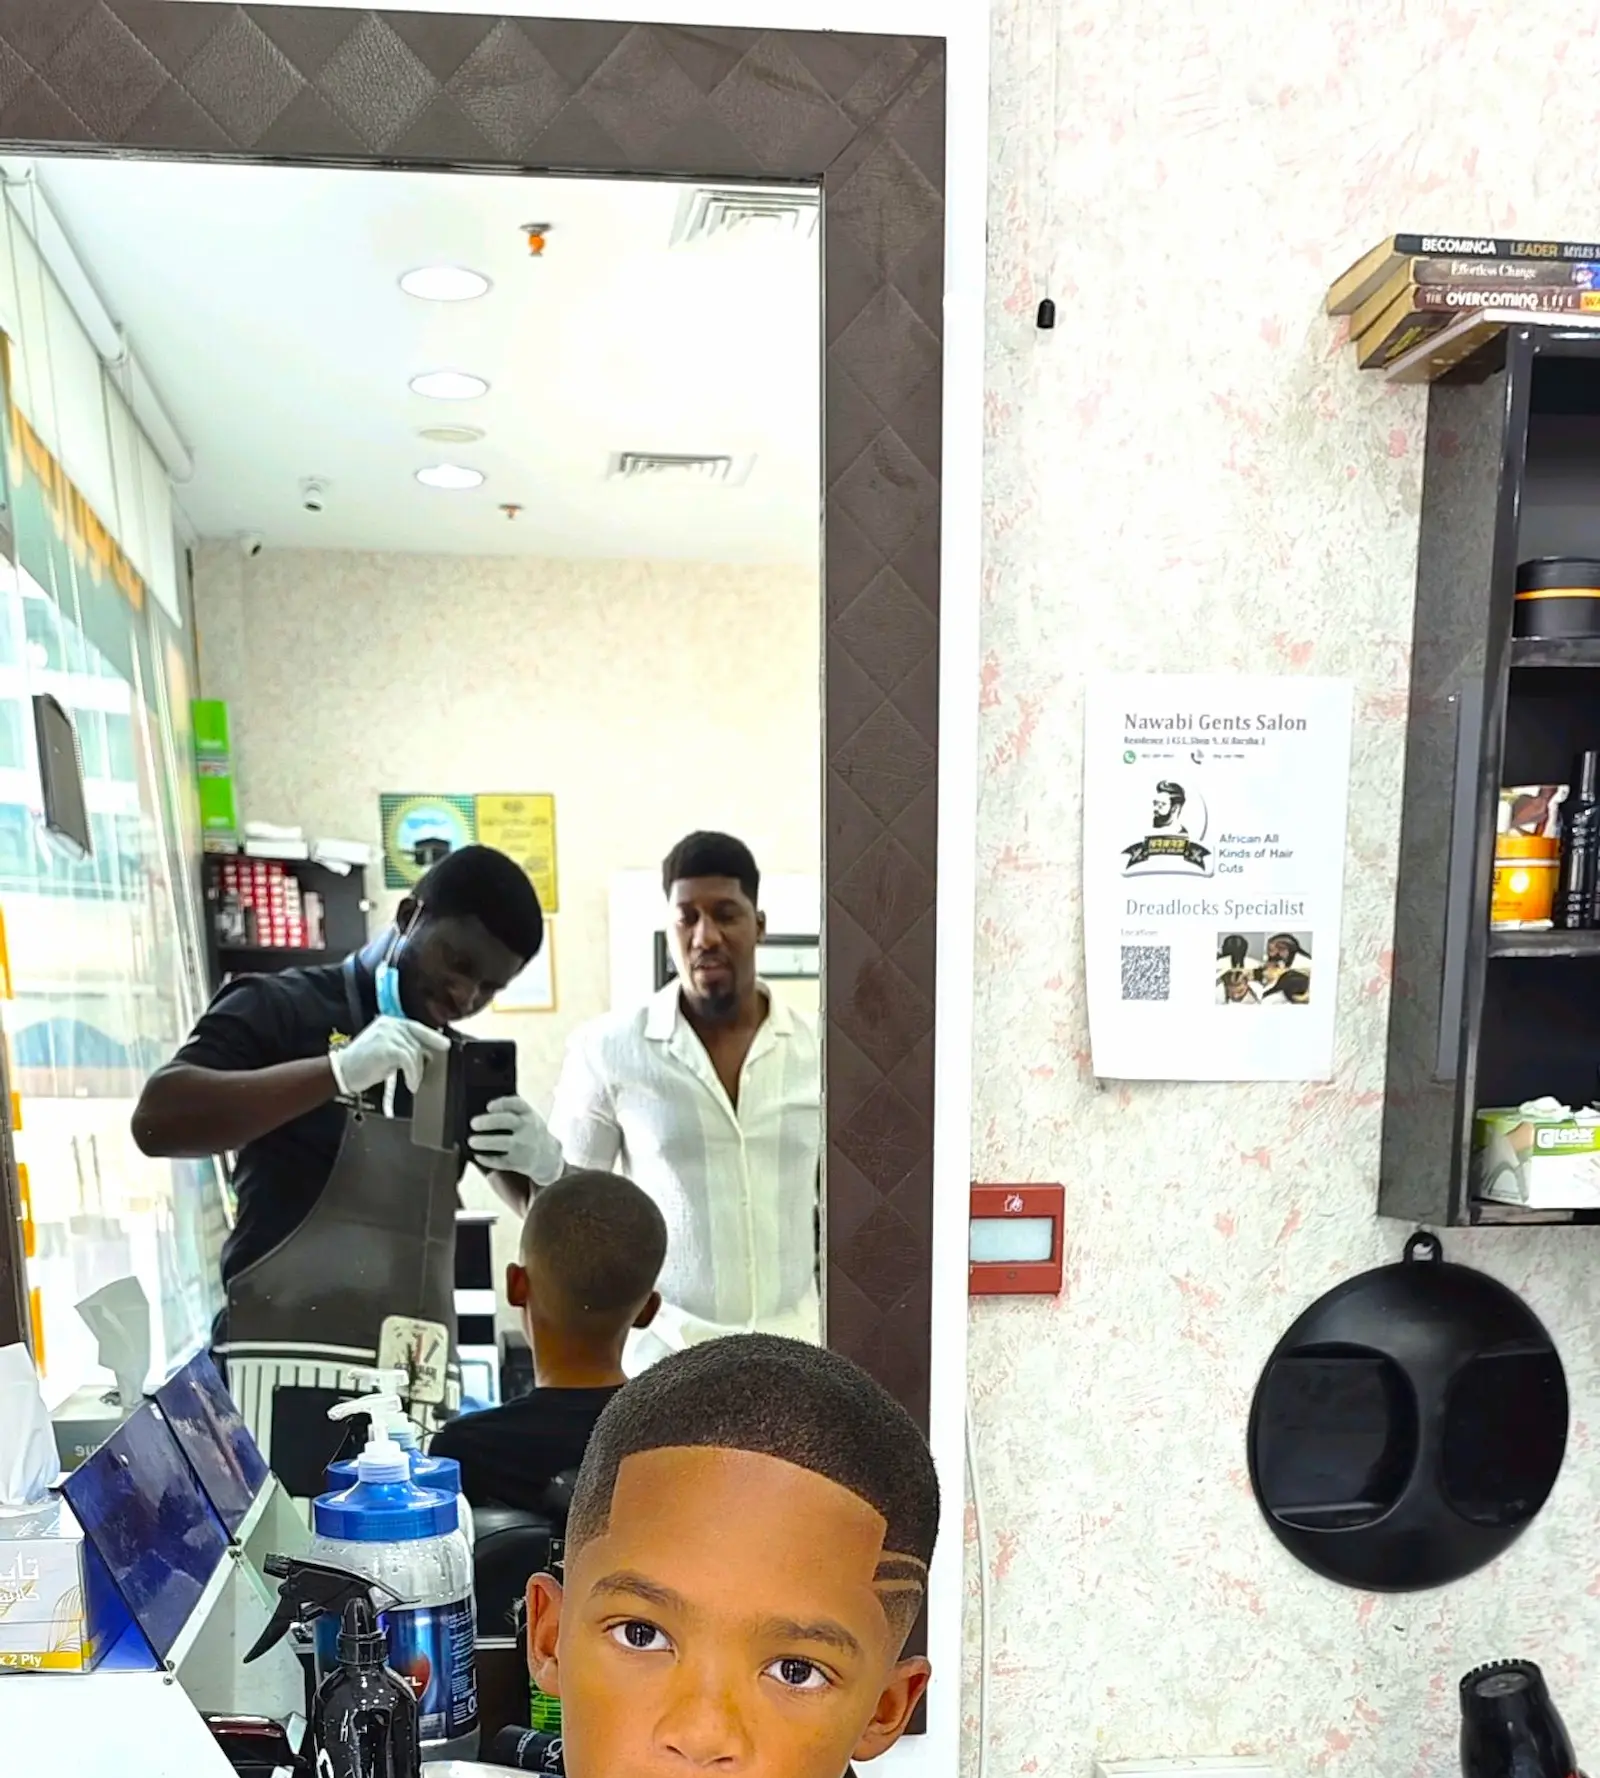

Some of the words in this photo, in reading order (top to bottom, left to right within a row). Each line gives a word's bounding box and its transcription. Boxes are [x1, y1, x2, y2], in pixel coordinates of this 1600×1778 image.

[1510, 243, 1557, 257] LEADER
[1499, 263, 1537, 281] Change
[1124, 713, 1193, 730] Nawabi
[1199, 714, 1251, 731] Gents
[1256, 714, 1307, 731] Salon
[1219, 834, 1261, 843] African
[1264, 834, 1279, 843] All
[1218, 849, 1250, 858] Kinds
[1254, 849, 1265, 858] of
[1269, 849, 1293, 858] Hair
[1218, 863, 1244, 873] Cuts
[1126, 899, 1219, 915] Dreadlocks
[1224, 899, 1304, 919] Specialist
[9, 1654, 18, 1665] 2
[21, 1654, 42, 1668] Ply
